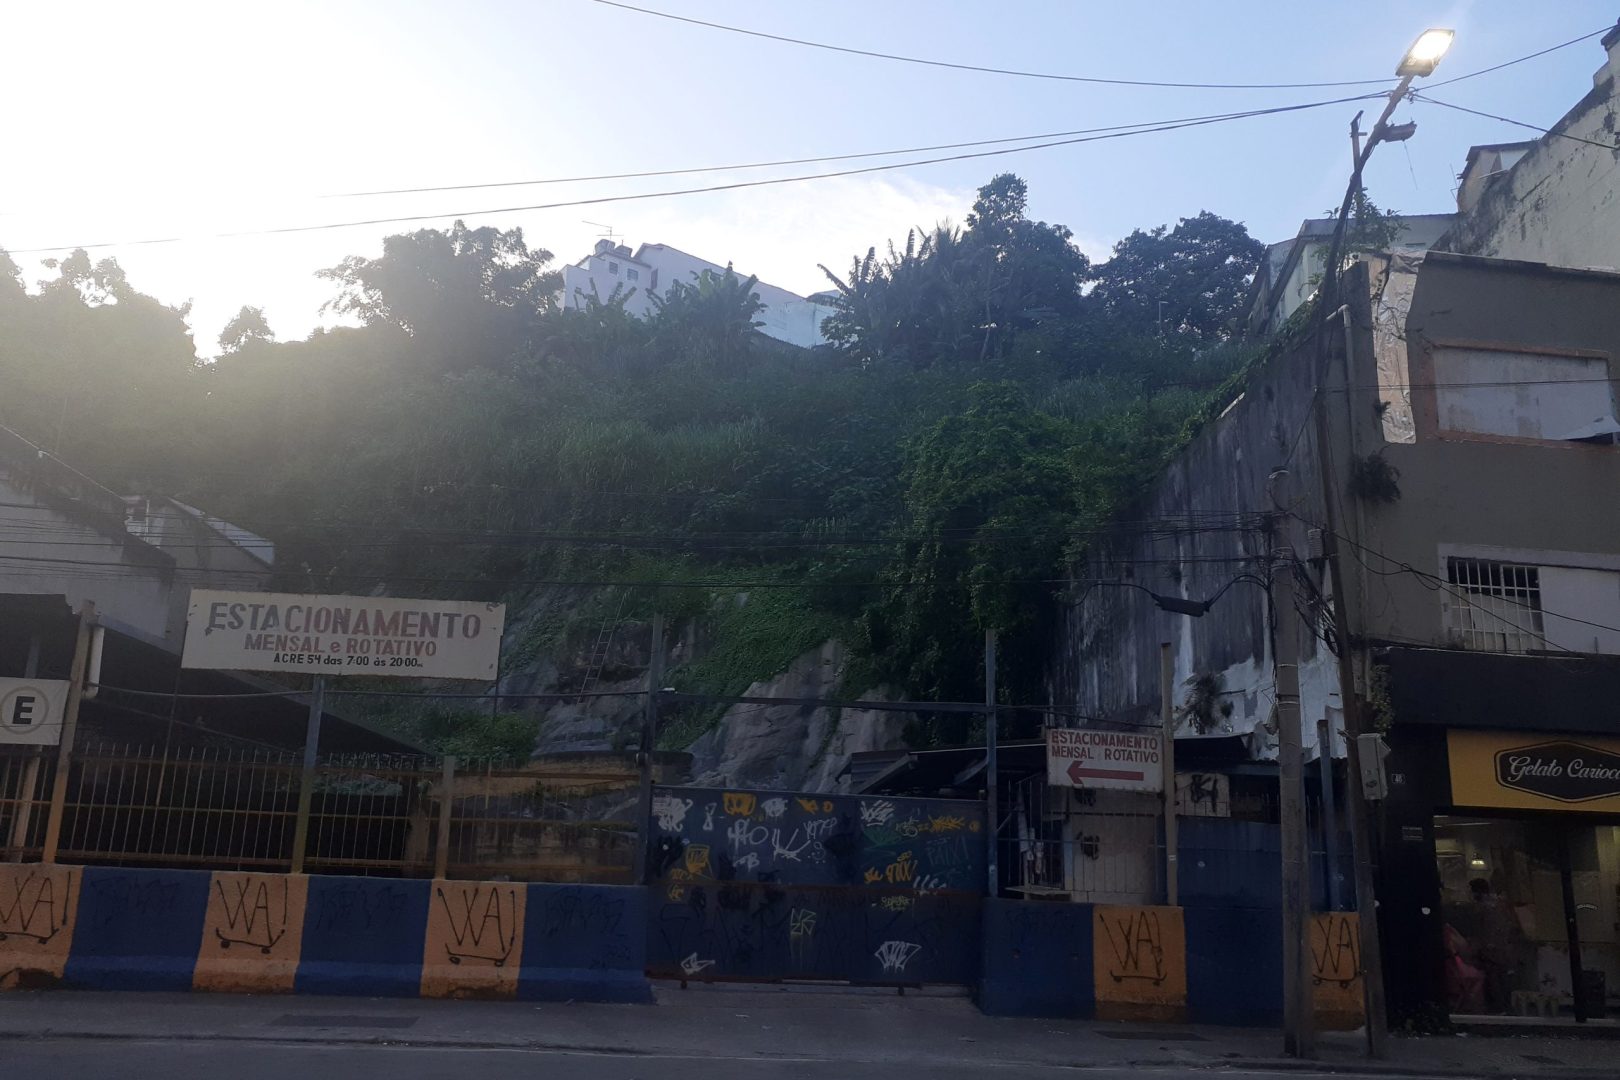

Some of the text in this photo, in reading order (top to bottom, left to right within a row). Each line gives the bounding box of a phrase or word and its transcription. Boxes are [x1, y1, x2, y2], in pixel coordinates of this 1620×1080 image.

[209, 602, 481, 639] ESTACIONAMENTO
[244, 633, 437, 657] MENSAL e ROTATIVO
[273, 652, 305, 664] ACRE
[307, 654, 322, 665] 54
[323, 655, 343, 666] das
[12, 695, 36, 725] E
[1051, 730, 1158, 750] ESTACIONAMENTO
[1051, 745, 1159, 764] MENSAL ROTATIVO
[1508, 756, 1563, 782] Gelato
